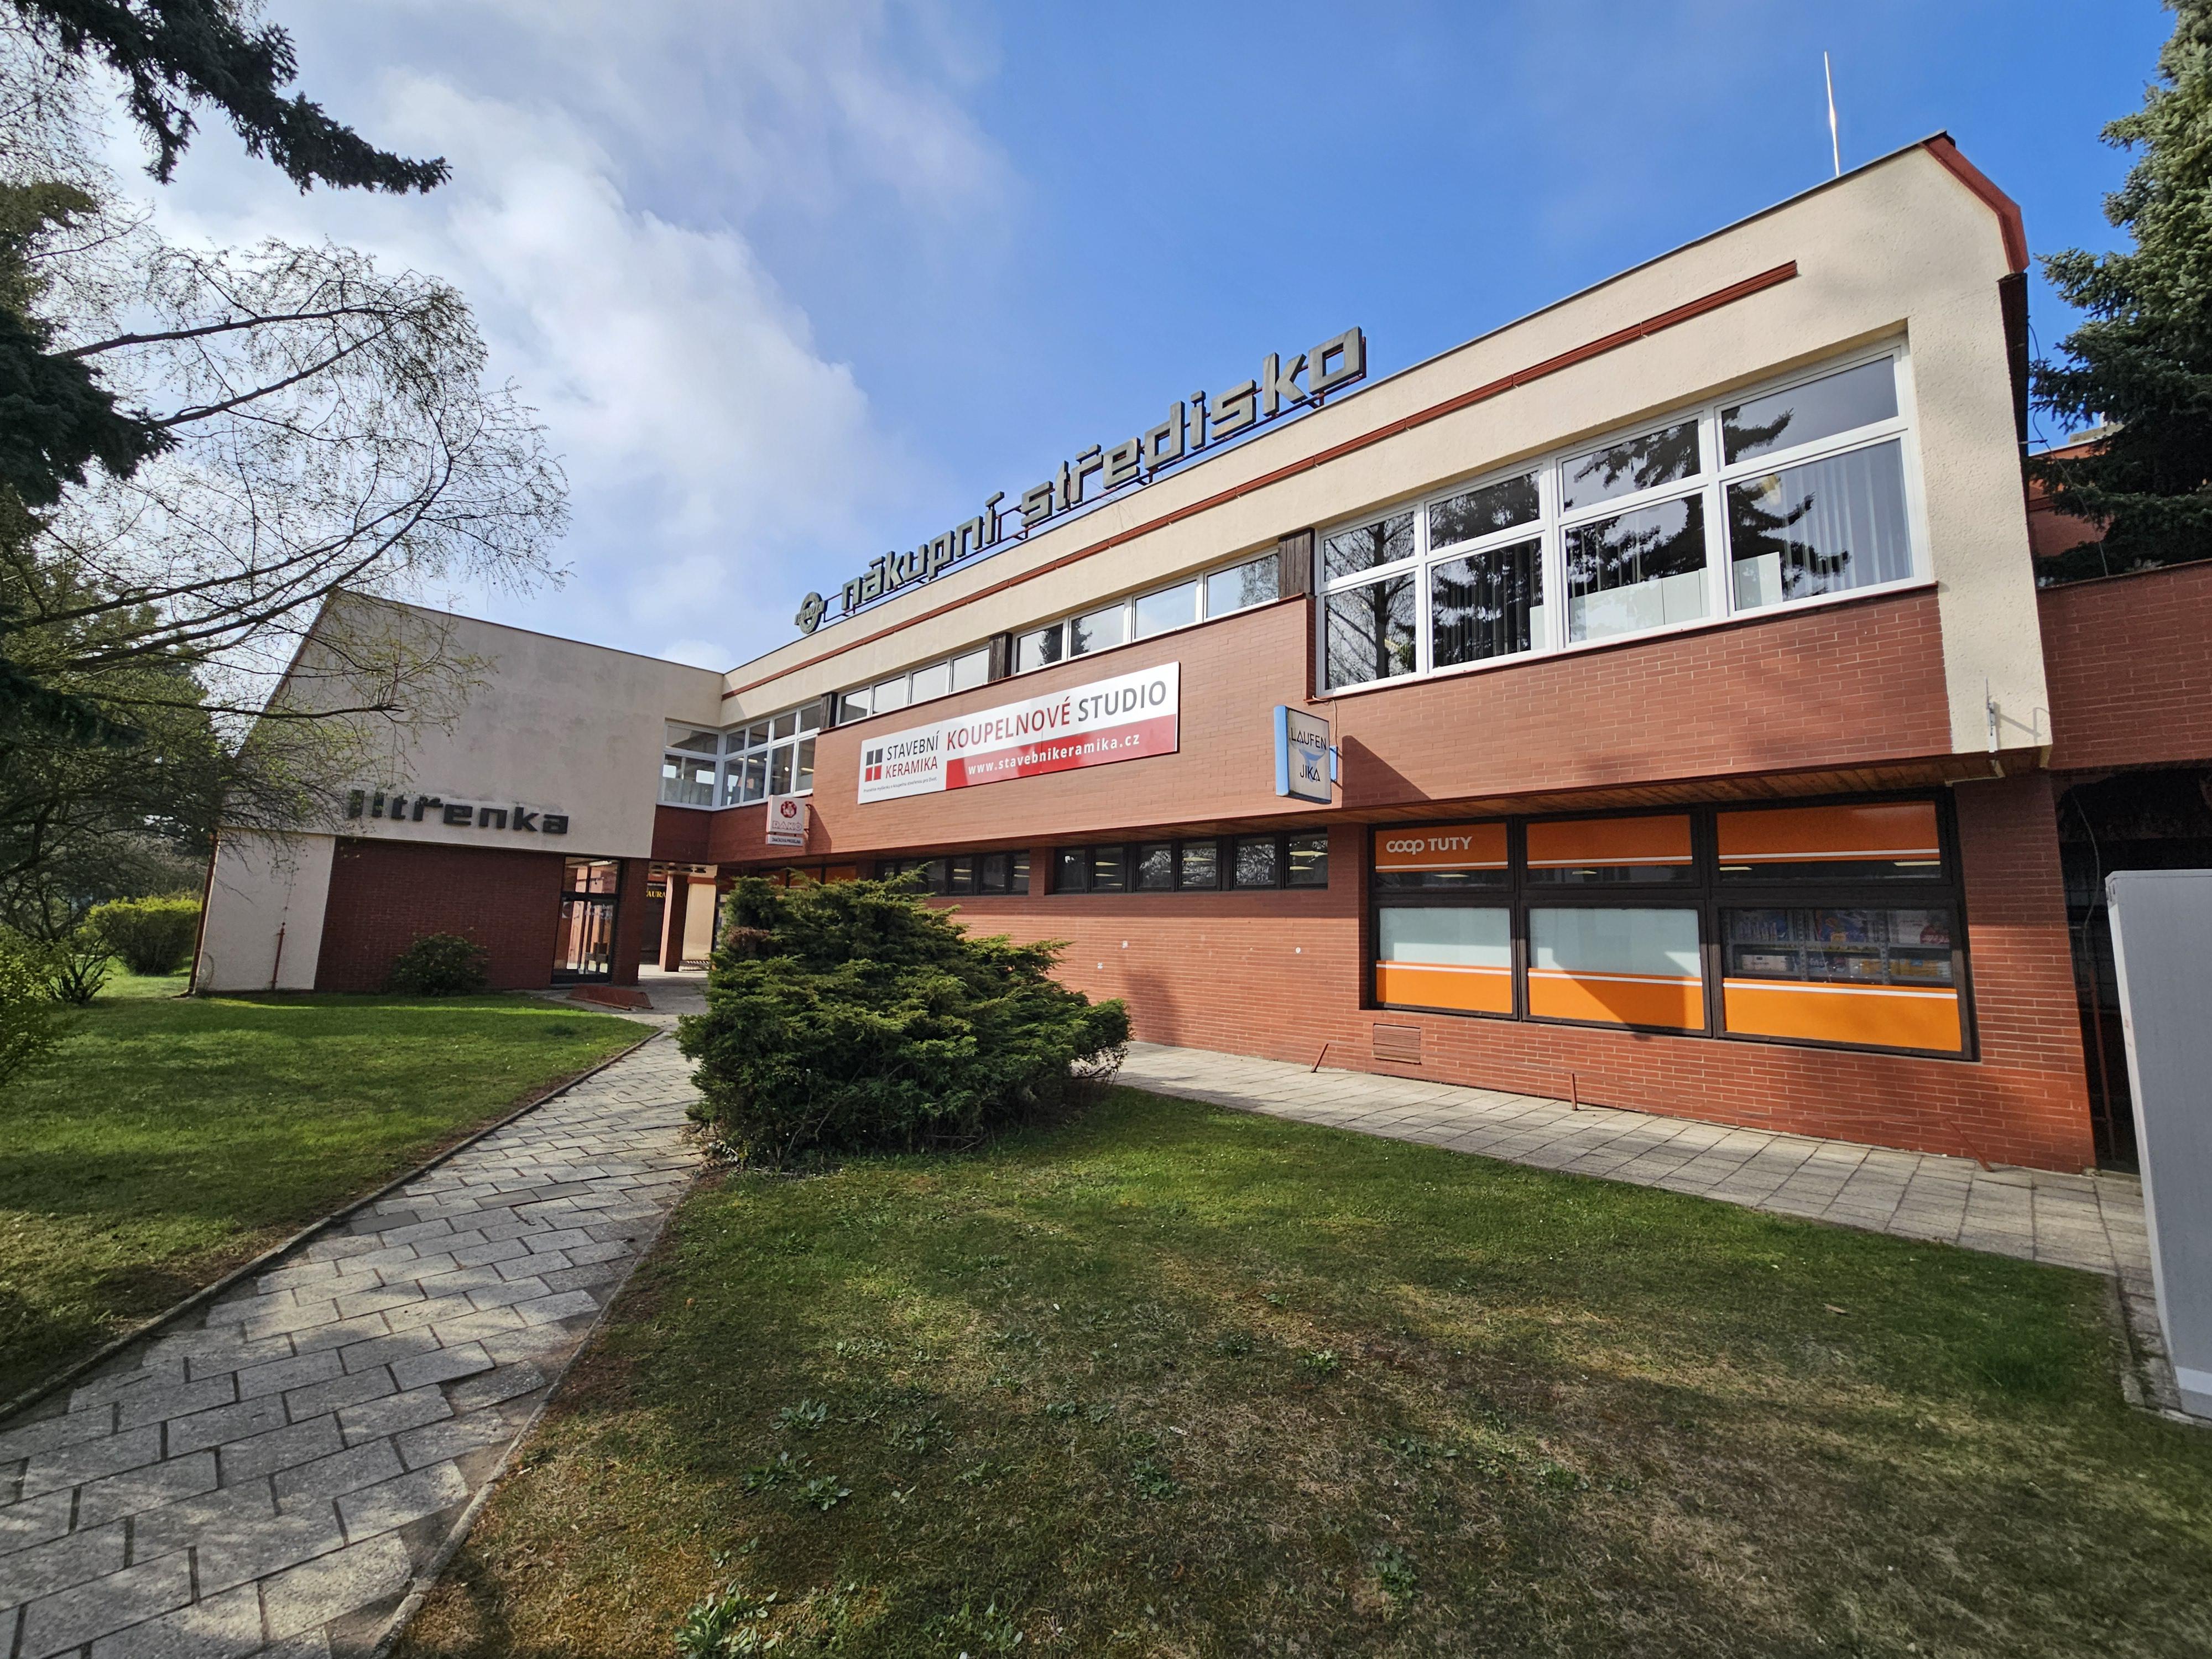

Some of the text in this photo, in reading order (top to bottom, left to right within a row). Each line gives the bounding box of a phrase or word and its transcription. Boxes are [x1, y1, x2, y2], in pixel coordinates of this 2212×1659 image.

[841, 326, 1367, 611] nákupní středisko
[947, 680, 1166, 751] KOUPELNOVÉ STUDIO
[887, 730, 940, 761] STAVEBNÍ
[1291, 727, 1327, 750] LAUFEN
[968, 733, 1140, 775] www.stavebnikeramika.cz
[885, 756, 938, 779] KERAMIKA
[1300, 764, 1321, 781] JIKA
[772, 821, 802, 831] RAKO
[1386, 836, 1473, 855] coop TUTY
